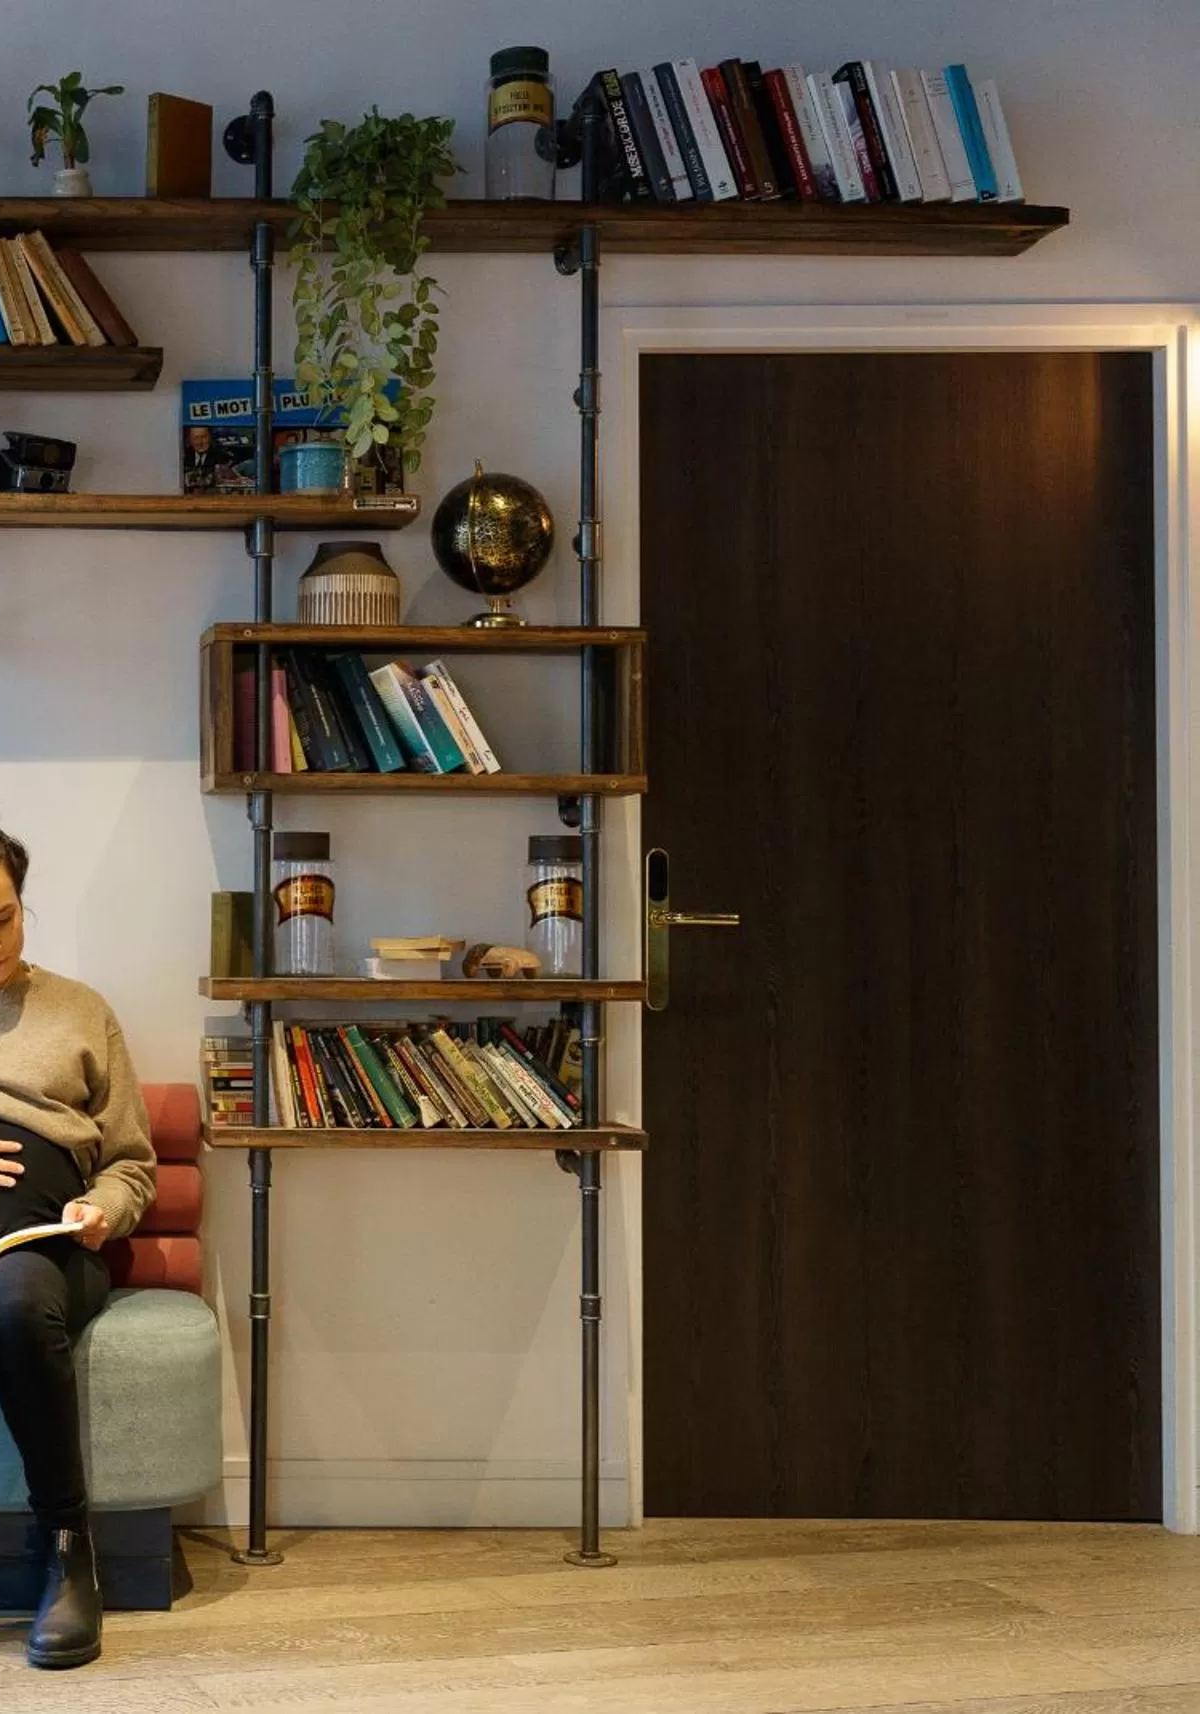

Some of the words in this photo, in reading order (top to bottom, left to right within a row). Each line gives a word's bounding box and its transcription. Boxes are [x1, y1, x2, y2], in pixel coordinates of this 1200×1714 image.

[192, 404, 209, 417] LE
[217, 401, 248, 415] MOT
[282, 395, 310, 409] PLU
